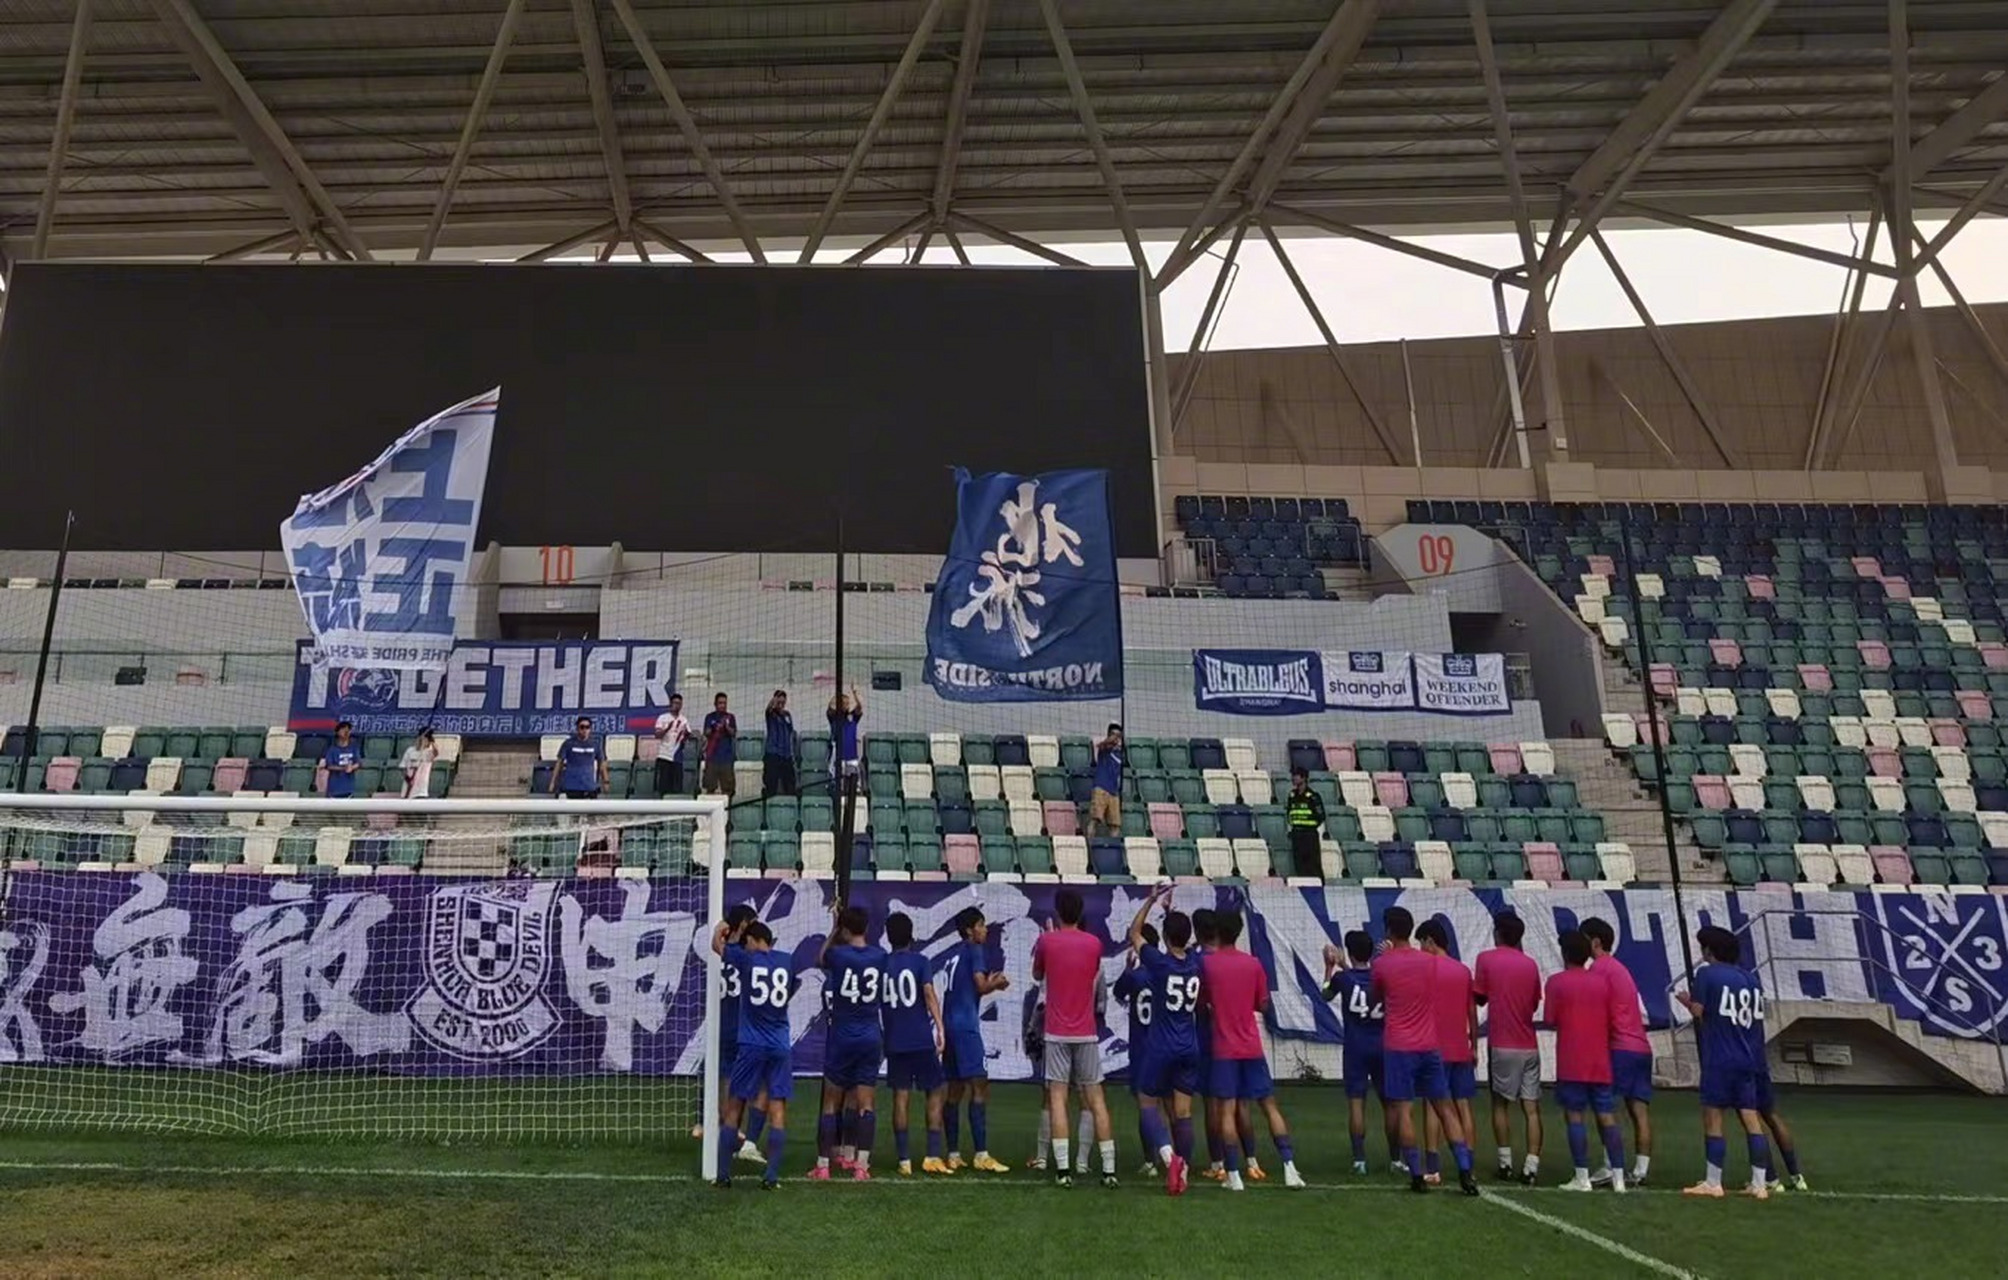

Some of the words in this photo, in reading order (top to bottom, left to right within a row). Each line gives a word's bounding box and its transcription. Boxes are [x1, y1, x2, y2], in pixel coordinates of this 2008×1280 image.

[539, 544, 574, 586] 10
[1418, 534, 1454, 575] 09
[1203, 655, 1310, 695] ULTRABLEUS
[1329, 680, 1407, 698] shanghai
[1427, 680, 1498, 693] WEEKEND
[1425, 692, 1501, 705] OFFENDER
[1921, 893, 1960, 925] N
[477, 973, 531, 1011] BLUE
[520, 911, 543, 976] DEVIL
[750, 966, 789, 1008] 58
[840, 966, 880, 1004] 43
[883, 967, 917, 1009] 40
[1165, 974, 1200, 1013] 59
[1944, 976, 1973, 1013] S
